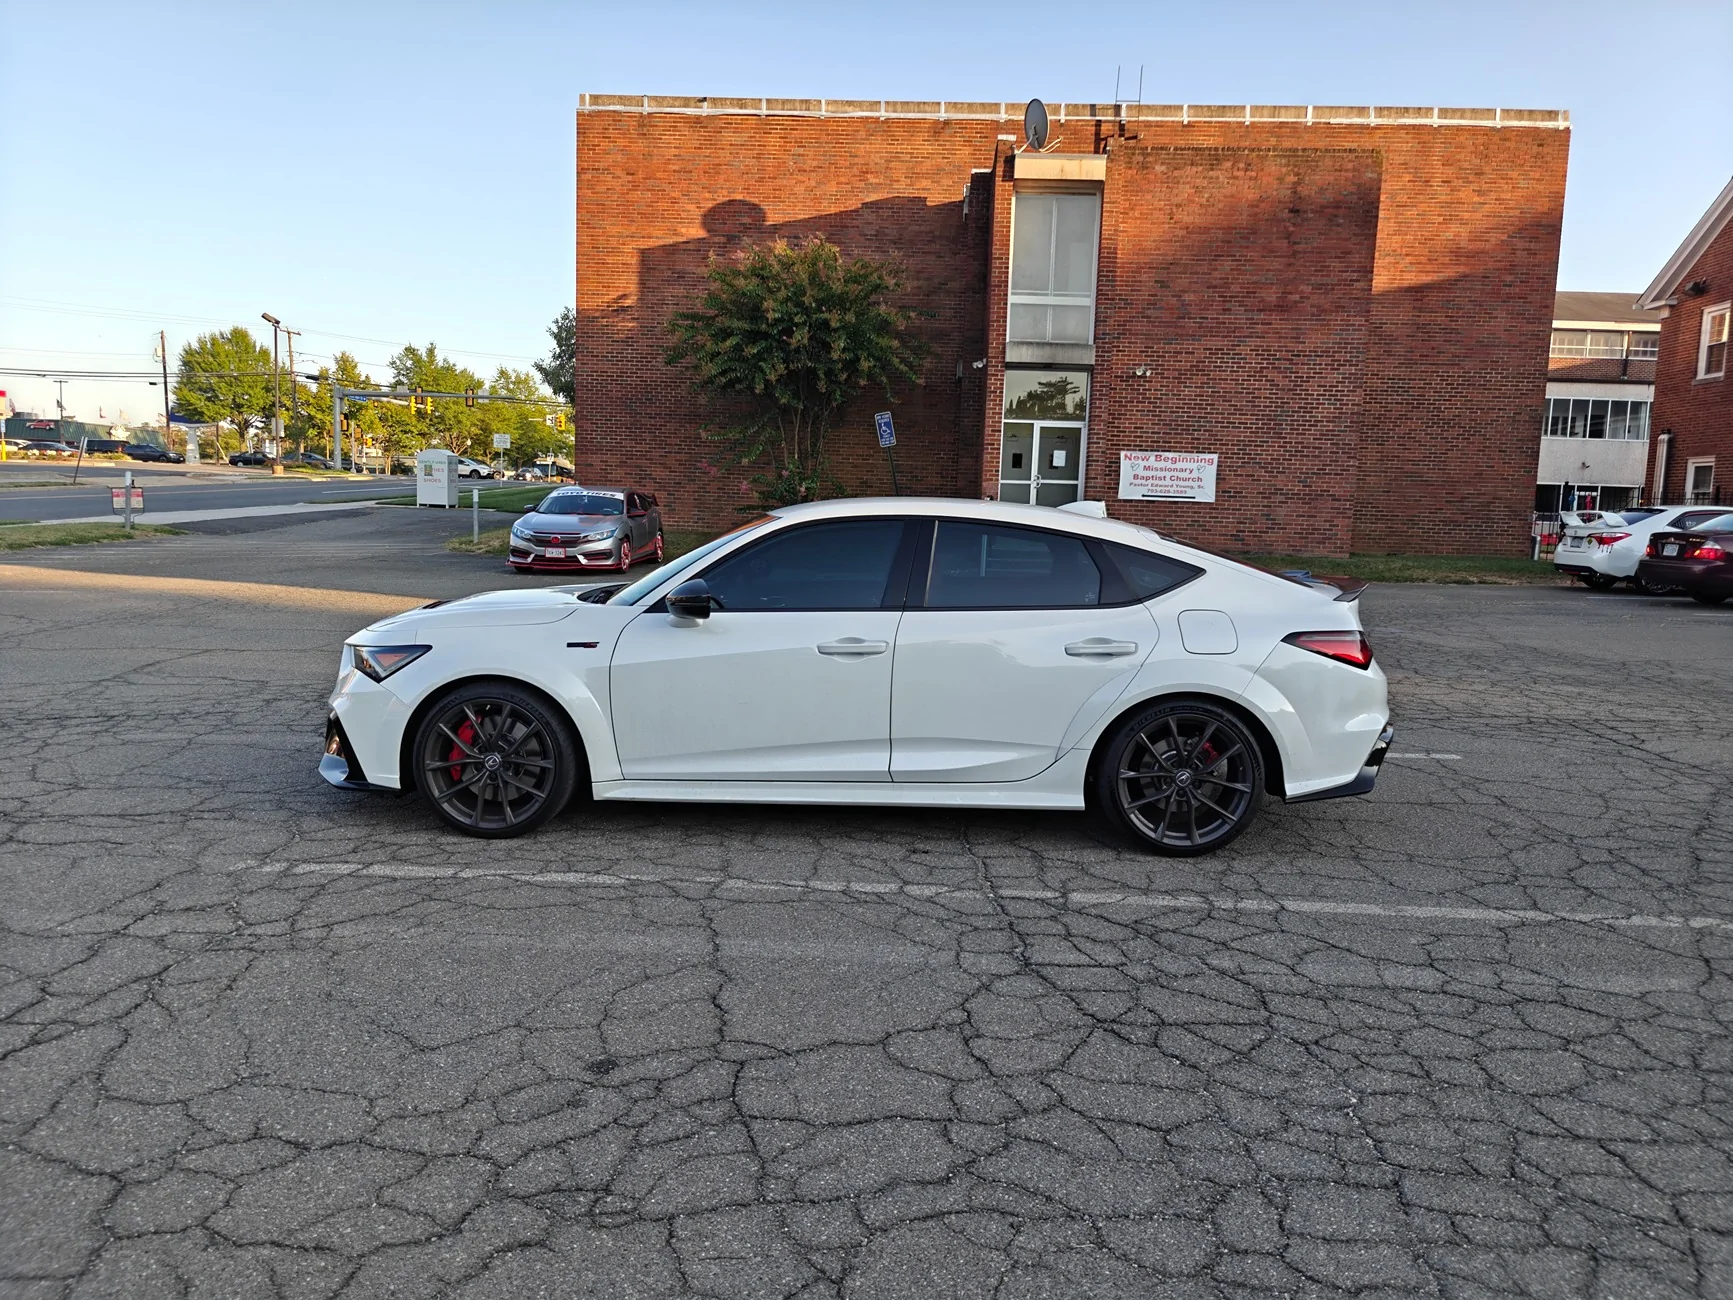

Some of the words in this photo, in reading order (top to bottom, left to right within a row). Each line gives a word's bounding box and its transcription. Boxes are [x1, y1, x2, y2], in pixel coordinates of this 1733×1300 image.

[1124, 453, 1151, 462] New
[1154, 454, 1214, 465] Beginning
[1143, 465, 1194, 474] Missionary
[1133, 474, 1167, 482] Baptist
[1169, 475, 1203, 483] Church
